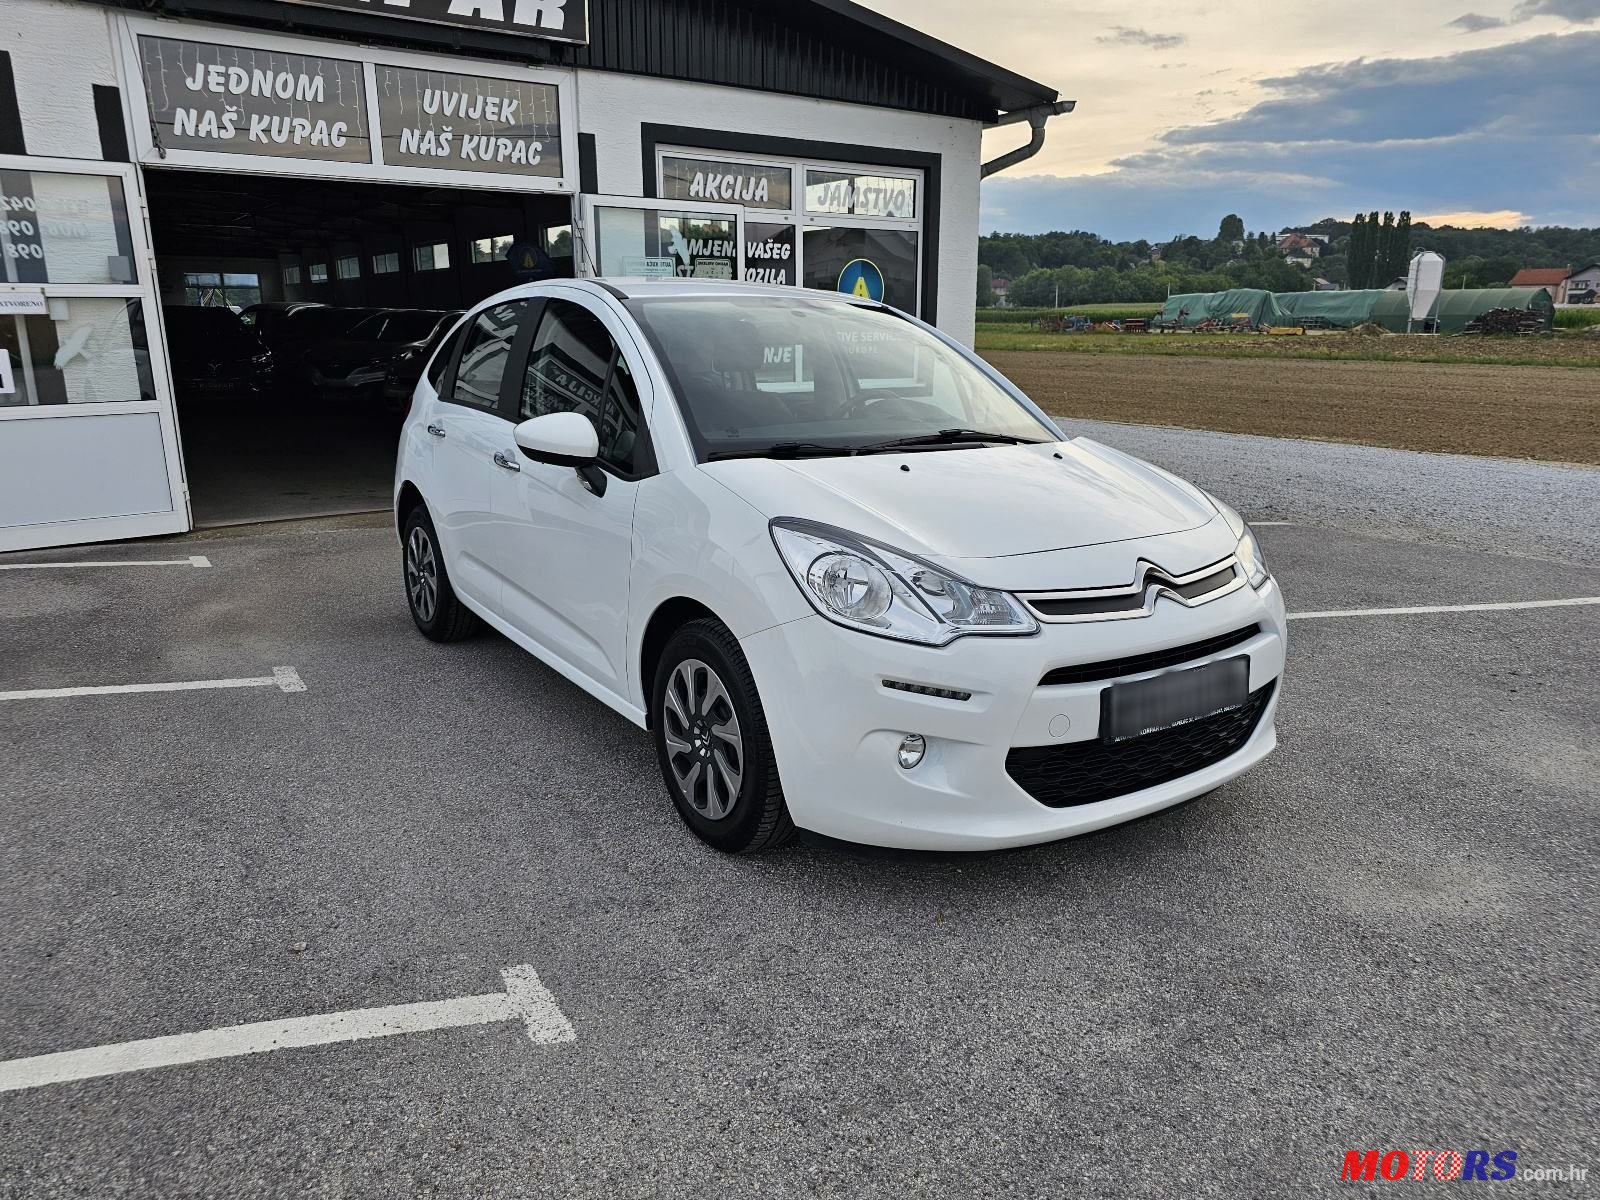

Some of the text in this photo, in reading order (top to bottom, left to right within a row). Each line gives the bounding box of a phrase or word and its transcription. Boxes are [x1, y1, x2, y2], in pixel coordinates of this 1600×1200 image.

[185, 62, 324, 103] JEDNOM
[423, 88, 519, 126] UVIJEK
[173, 105, 348, 148] NAŠ KUPAC
[399, 125, 543, 166] NAŠ KUPAC
[689, 172, 769, 203] AKCIJA
[816, 183, 906, 212] JAMSTVO
[747, 238, 791, 260] VAŠEG
[763, 346, 793, 364] NJE
